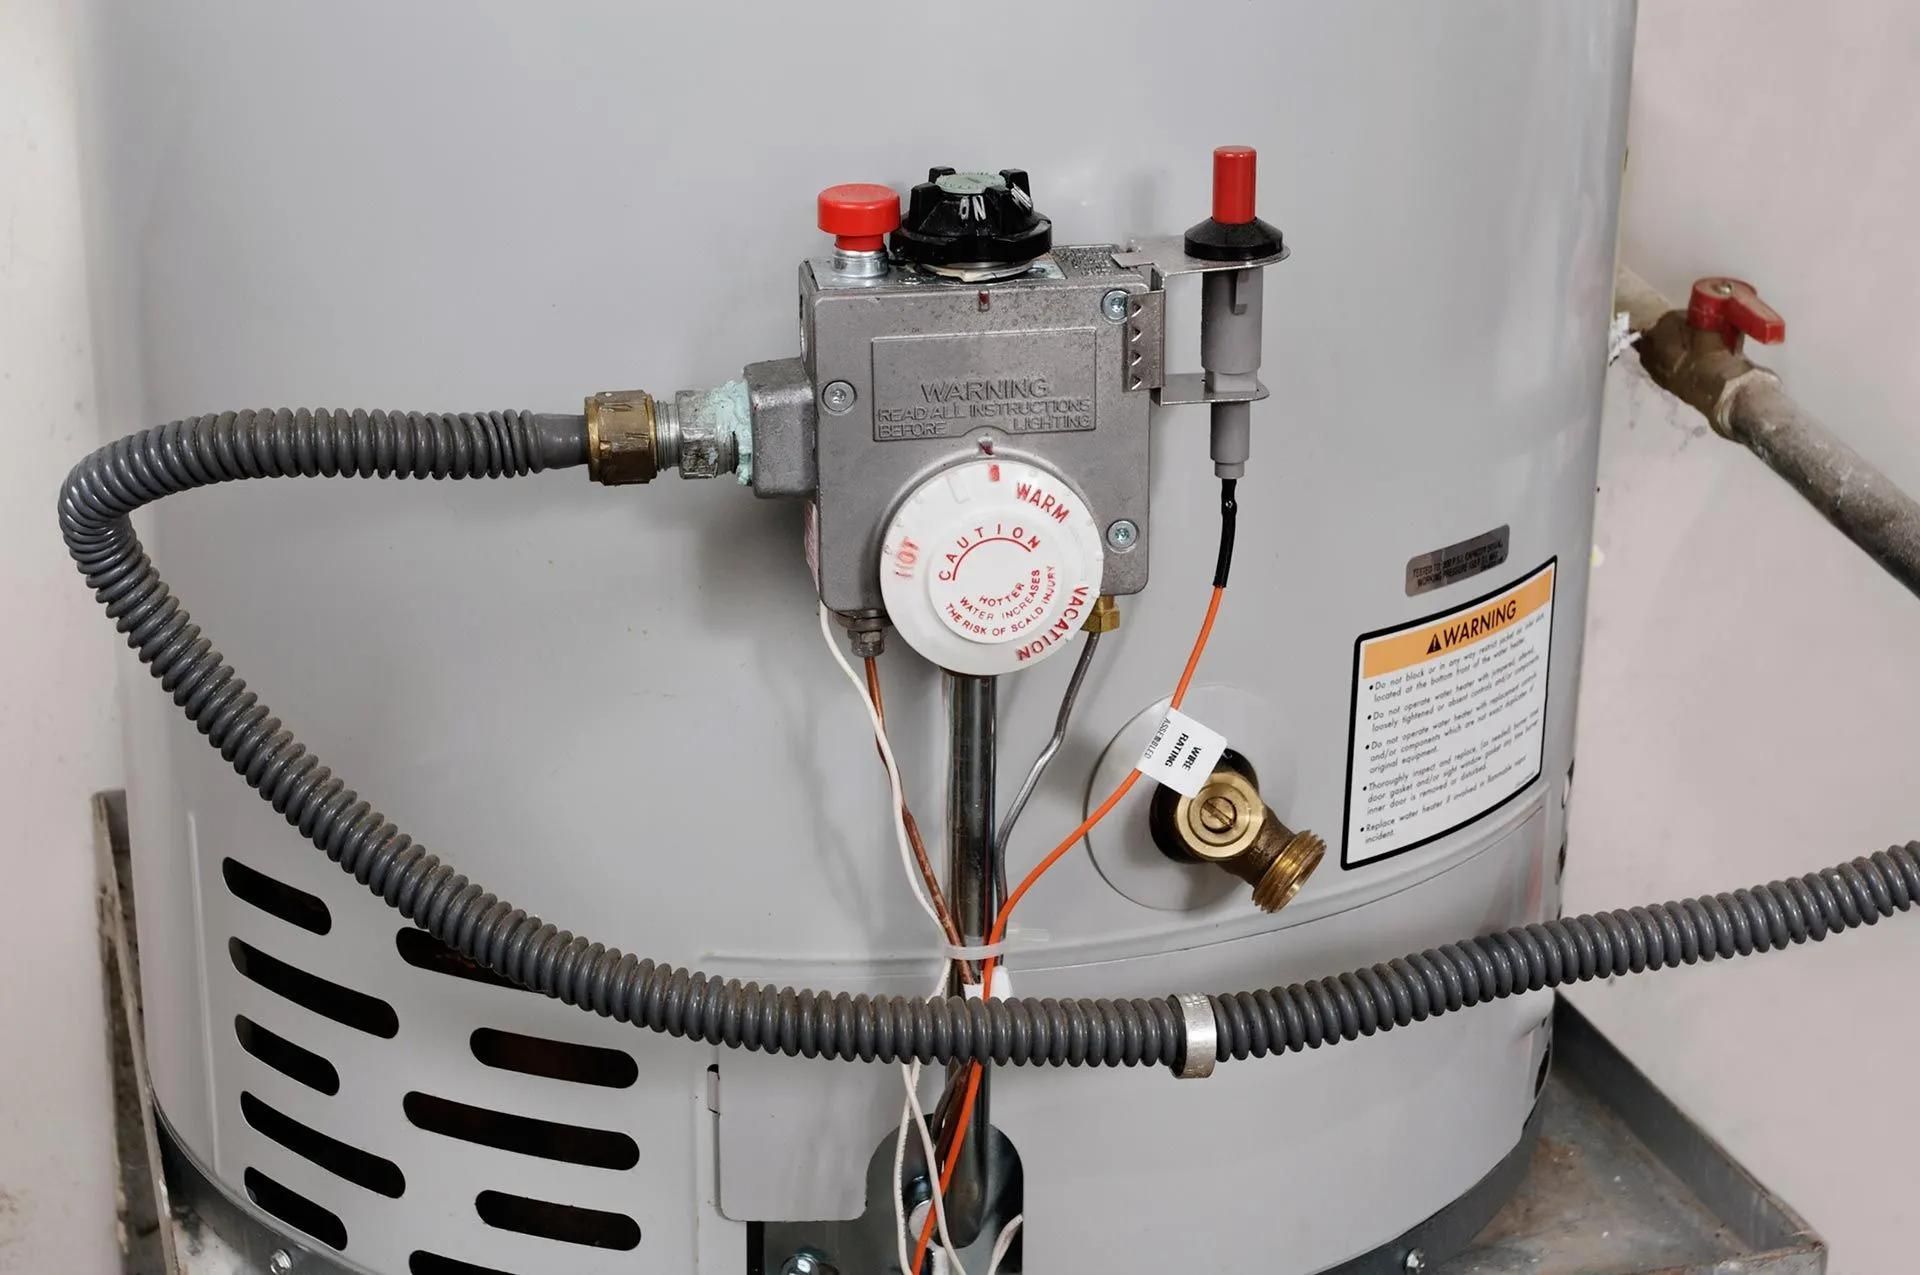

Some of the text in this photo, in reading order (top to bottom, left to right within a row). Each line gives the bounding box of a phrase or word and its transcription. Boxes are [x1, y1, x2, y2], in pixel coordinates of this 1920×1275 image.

[959, 195, 987, 221] ON
[920, 378, 1050, 402] WARNING
[877, 398, 1091, 422] READ ALL INSTRUCTIONS
[878, 414, 1091, 438] BEFORE LIGHTING
[1016, 482, 1070, 523] WARM
[938, 524, 1041, 581] CAUTION
[945, 565, 1056, 636] THE RISK OF SCALD INJURY
[960, 569, 1040, 620] WATER INCREASES
[979, 582, 1025, 607] HOTTER
[1016, 585, 1089, 661] VACATION
[1444, 600, 1516, 648] WARNING
[1374, 688, 1401, 702] located
[1416, 681, 1427, 690] the
[1430, 672, 1453, 686] bottom
[1482, 655, 1491, 664] the
[1375, 681, 1386, 690] Do
[1390, 676, 1402, 686] not
[1406, 670, 1424, 681] block
[1373, 712, 1384, 721] Do
[1388, 706, 1401, 715] not
[1403, 697, 1430, 712] operate
[1435, 688, 1452, 700] water
[1456, 680, 1474, 692] heater
[1371, 740, 1382, 750] Do
[1386, 736, 1399, 745] not
[1401, 727, 1429, 742] operate
[1433, 718, 1451, 730] water
[1454, 709, 1473, 721] heater
[1372, 719, 1398, 733] loosely
[1402, 705, 1434, 725] tightened
[1437, 704, 1445, 712] or
[1164, 733, 1189, 768] RATING
[1182, 746, 1202, 771] WIRE
[1370, 748, 1397, 762] and/or
[1400, 734, 1441, 753] components
[1444, 724, 1461, 736] which
[1464, 720, 1475, 729] are
[1369, 758, 1398, 774] original
[1369, 771, 1409, 790] Thoroughly
[1413, 764, 1437, 778] inspect
[1439, 754, 1451, 767] and
[1367, 792, 1386, 803] door
[1390, 784, 1413, 799] gasket
[1416, 773, 1440, 788] and/or
[1367, 804, 1386, 816] inner
[1389, 797, 1407, 809] door
[1419, 781, 1448, 796] removed
[1366, 818, 1396, 832] Replace
[1399, 810, 1419, 821] water
[1422, 800, 1443, 813] heater
